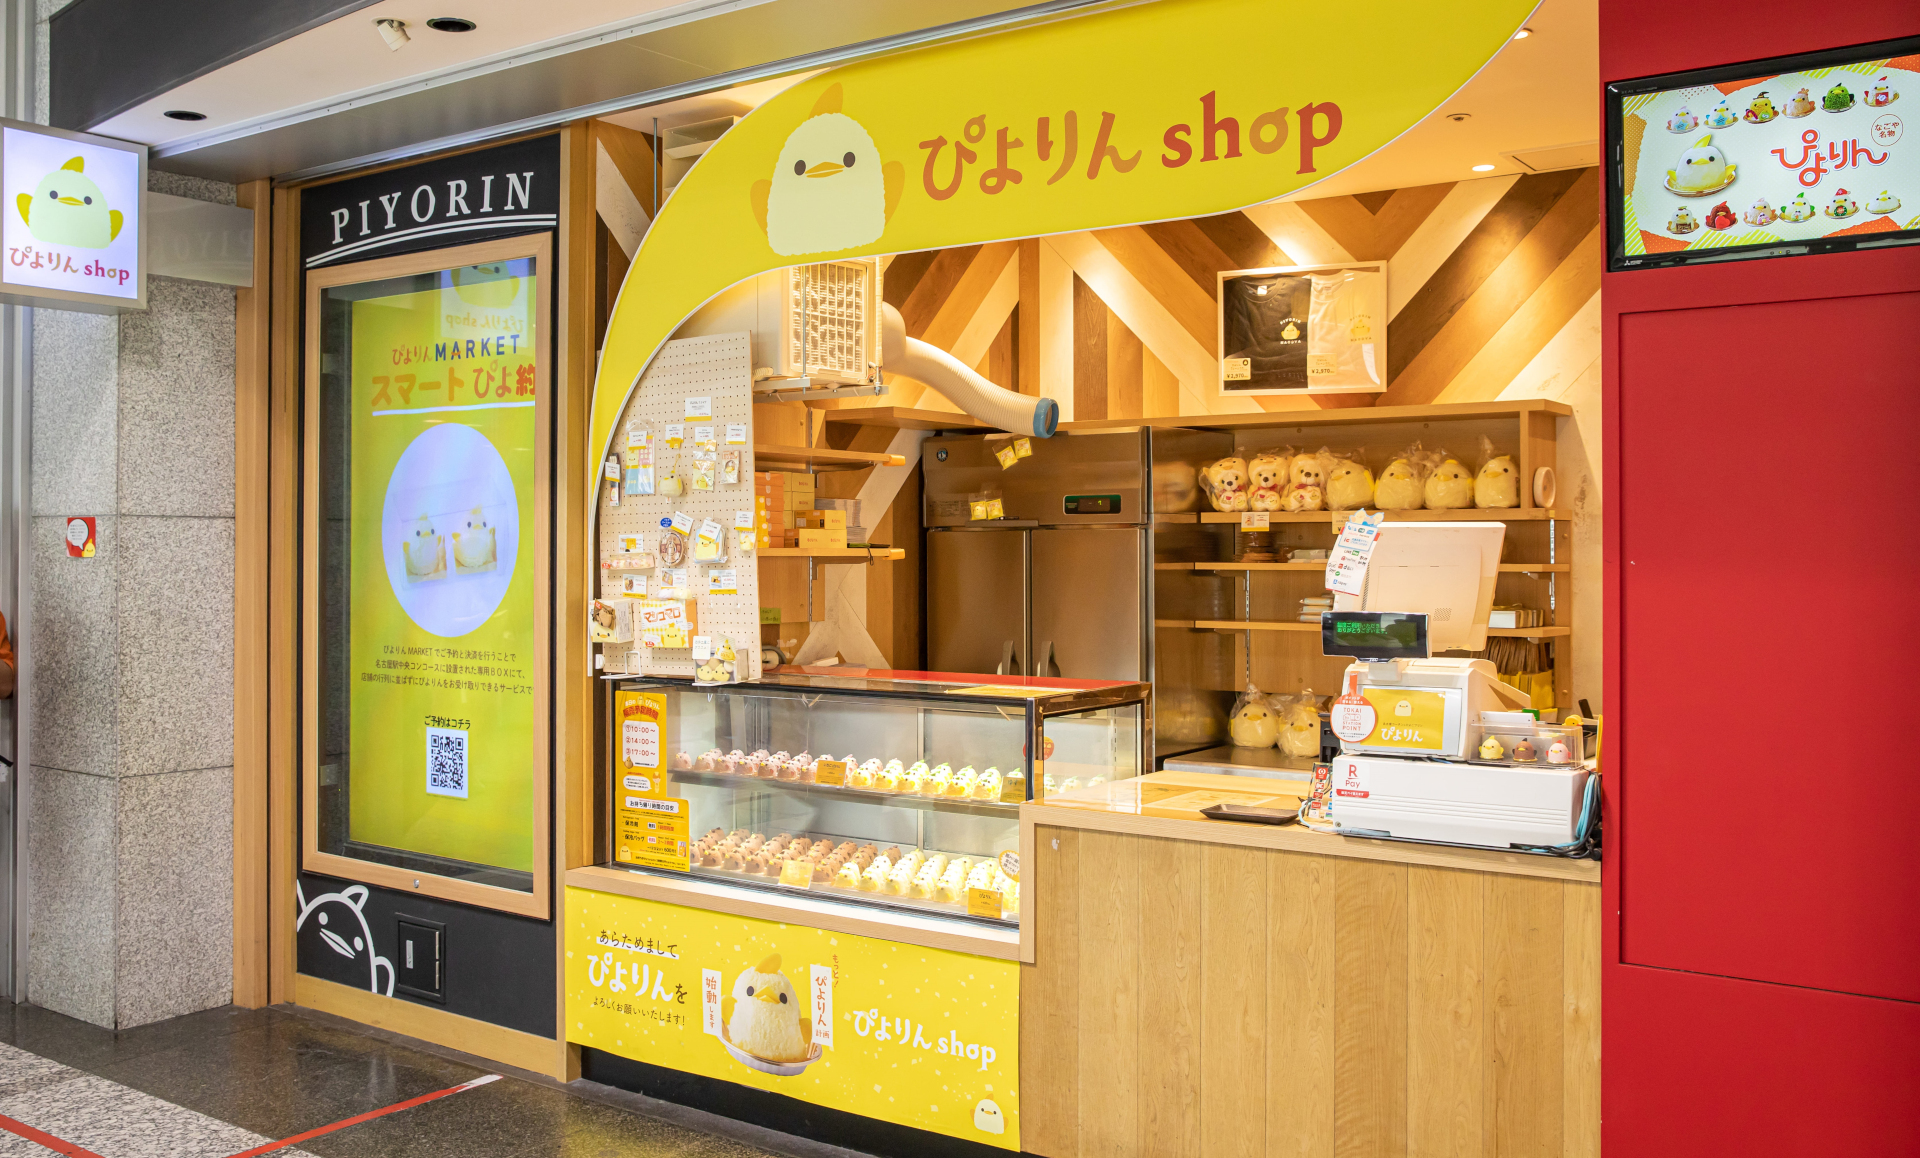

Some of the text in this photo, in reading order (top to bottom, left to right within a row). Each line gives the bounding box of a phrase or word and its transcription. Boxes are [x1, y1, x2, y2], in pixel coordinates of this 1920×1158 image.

[1874, 121, 1900, 132] なごや
[1878, 129, 1896, 139] 名物
[918, 89, 1343, 201] ぴよりん shop
[1770, 129, 1888, 187] ぴよりん
[330, 171, 534, 245] PIYORIN
[9, 245, 130, 286] ぴよりん shop
[435, 334, 520, 362] MARKET
[371, 366, 465, 407] スマート
[424, 714, 471, 730] ご予約はコチラ
[1381, 726, 1424, 742] ぴよりん
[1345, 780, 1361, 789] Pay
[1348, 764, 1358, 778] R
[599, 928, 678, 958] あらためまして
[705, 975, 718, 1030] 始動します
[852, 1008, 997, 1071] ぴよりん shop
